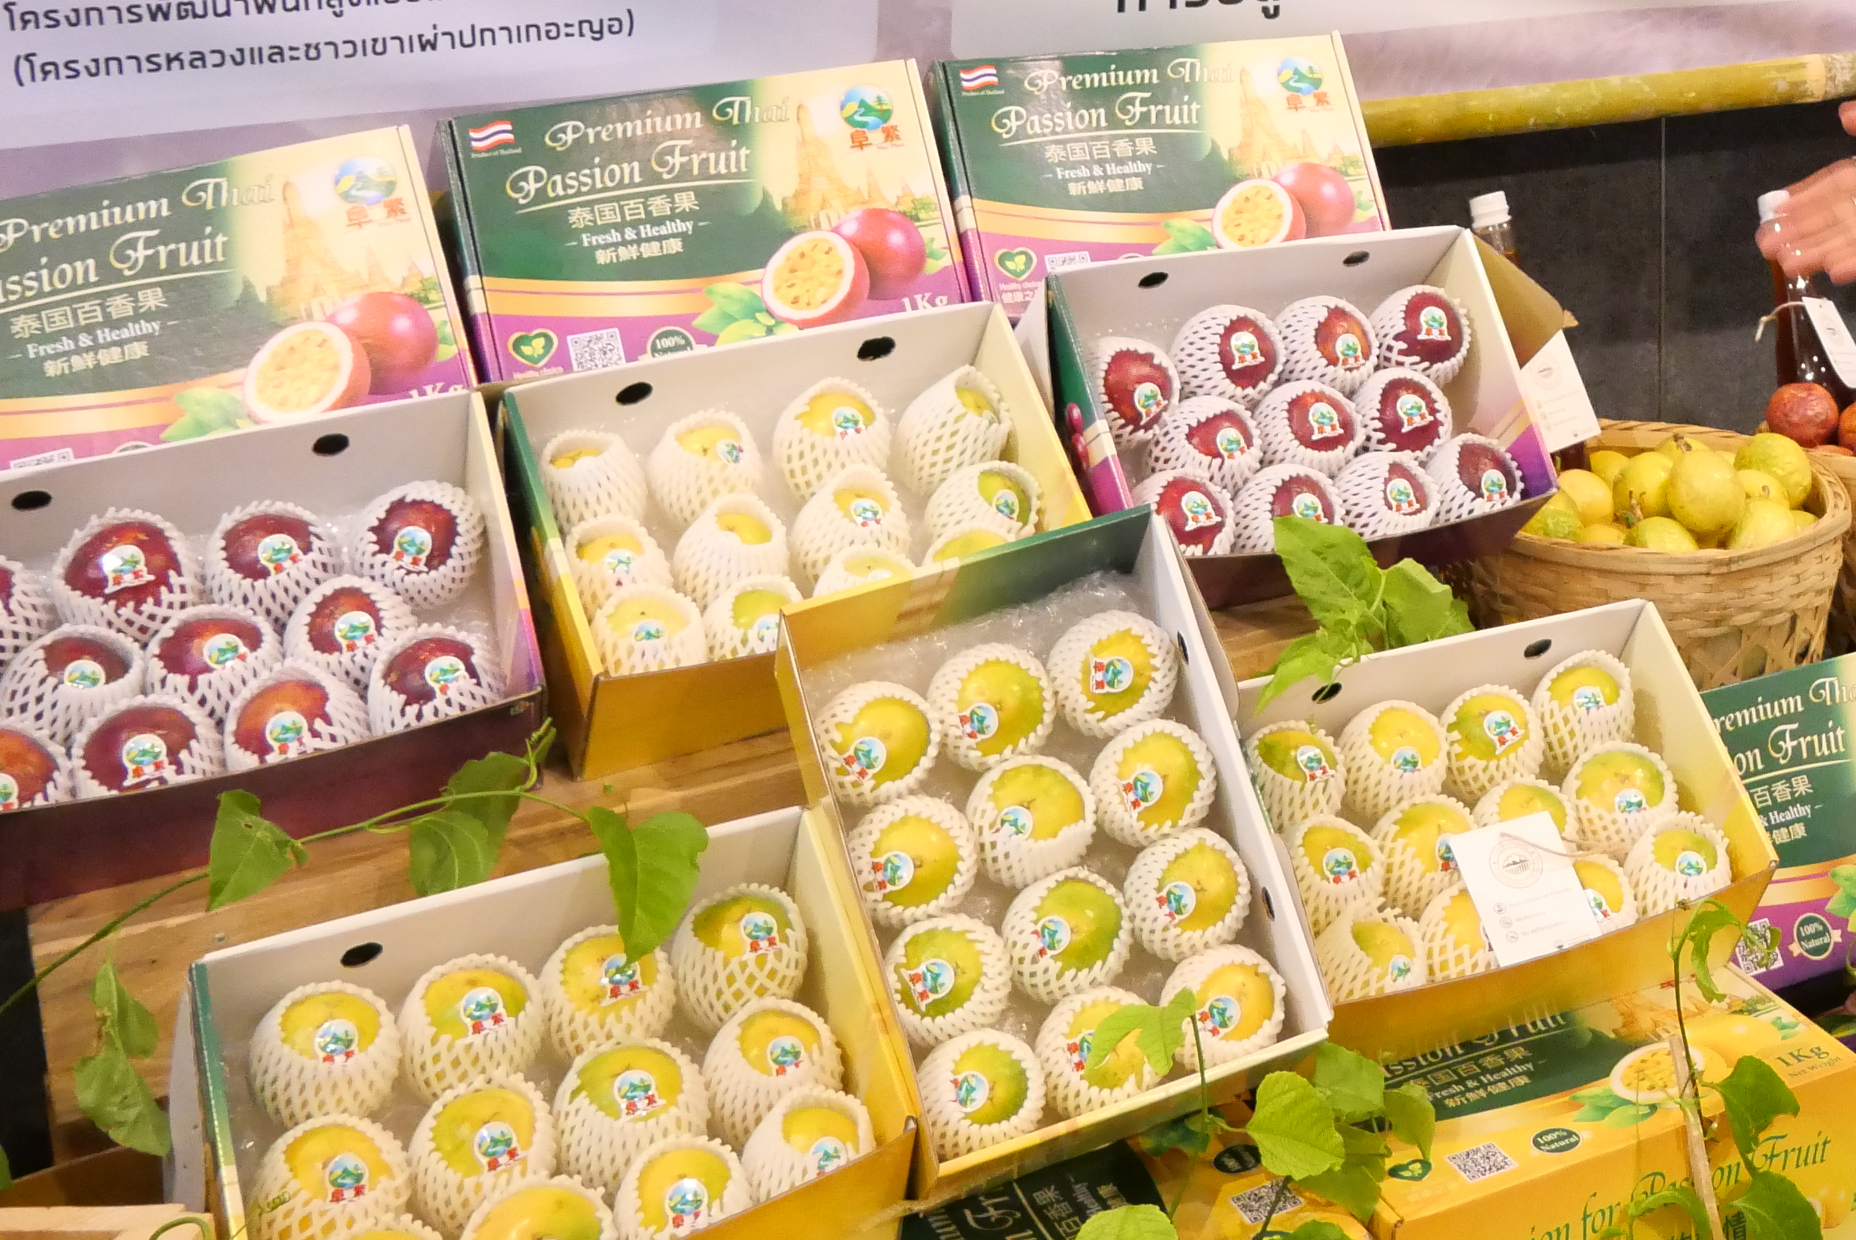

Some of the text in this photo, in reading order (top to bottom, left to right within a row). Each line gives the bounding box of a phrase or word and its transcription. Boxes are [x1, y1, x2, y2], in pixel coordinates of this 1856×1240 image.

[13, 8, 636, 87] (โครงการหลวงและชาวเขาเผ่าปกาเกอะญอ)
[1024, 57, 1234, 94] Premium Thai
[545, 95, 790, 151] Premium Thai
[991, 92, 1201, 139] Passion Fruit
[1045, 136, 1158, 163] 泰国百香果
[506, 139, 752, 205] Passion Fruit
[1057, 158, 1153, 179] Fresh & Healthy
[0, 174, 276, 253] Premium Thai
[567, 191, 700, 229] 泰国百香果
[109, 226, 229, 276] Fruit
[581, 218, 694, 247] Fresh & Healthy
[10, 287, 168, 340] 泰国百香果
[27, 318, 162, 359] Fresh & Healthy
[655, 335, 686, 349] 100%
[1713, 697, 1804, 735] remium
[1768, 720, 1846, 764] Fruit
[1748, 774, 1814, 809] 百香果
[1769, 803, 1811, 825] Healthy
[1799, 921, 1824, 936] 100%
[1801, 933, 1831, 951] Natural
[1466, 1078, 1480, 1088] &
[1480, 1060, 1534, 1084] Healthy
[1776, 1045, 1830, 1067] 1Kg
[1537, 1130, 1567, 1144] 100%
[1540, 1134, 1579, 1152] Natural
[1752, 1131, 1831, 1172] Fruit
[1581, 1192, 1622, 1238] for
